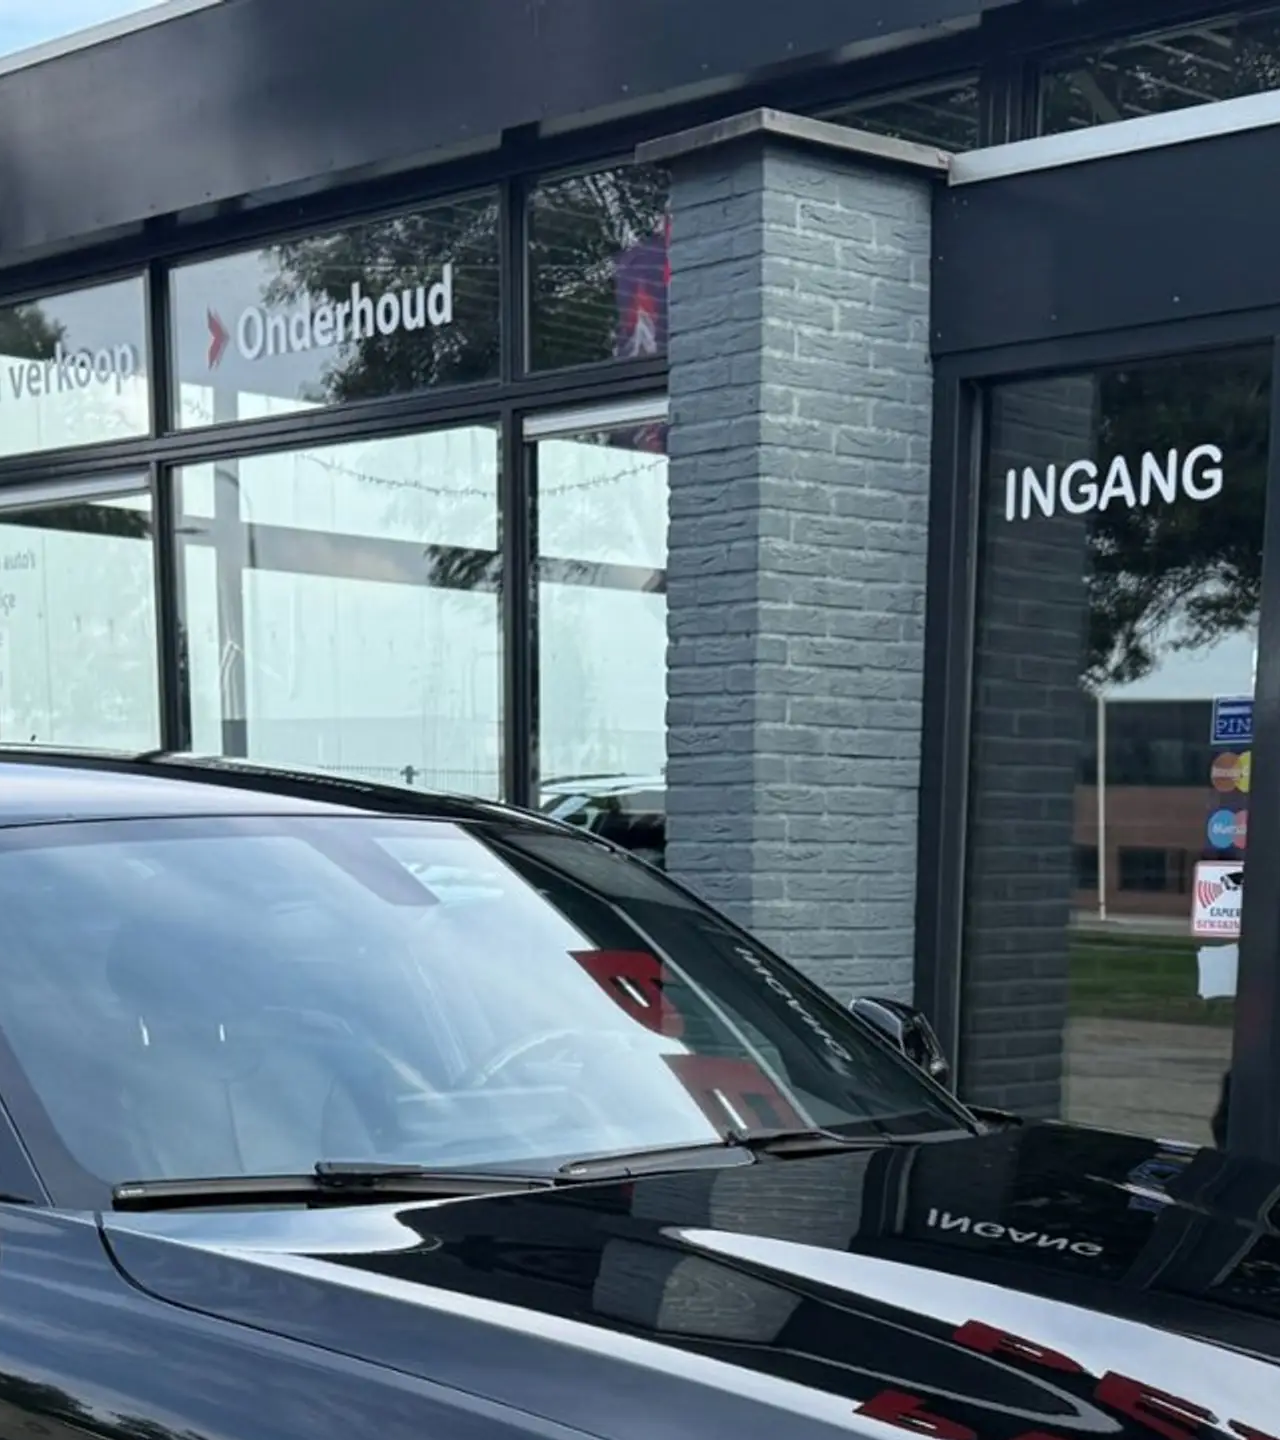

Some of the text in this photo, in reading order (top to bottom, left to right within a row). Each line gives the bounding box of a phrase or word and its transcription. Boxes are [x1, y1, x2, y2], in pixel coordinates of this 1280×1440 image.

[236, 261, 453, 361] Onderhoud
[8, 341, 136, 399] verkoop
[1005, 443, 1224, 522] INGANG
